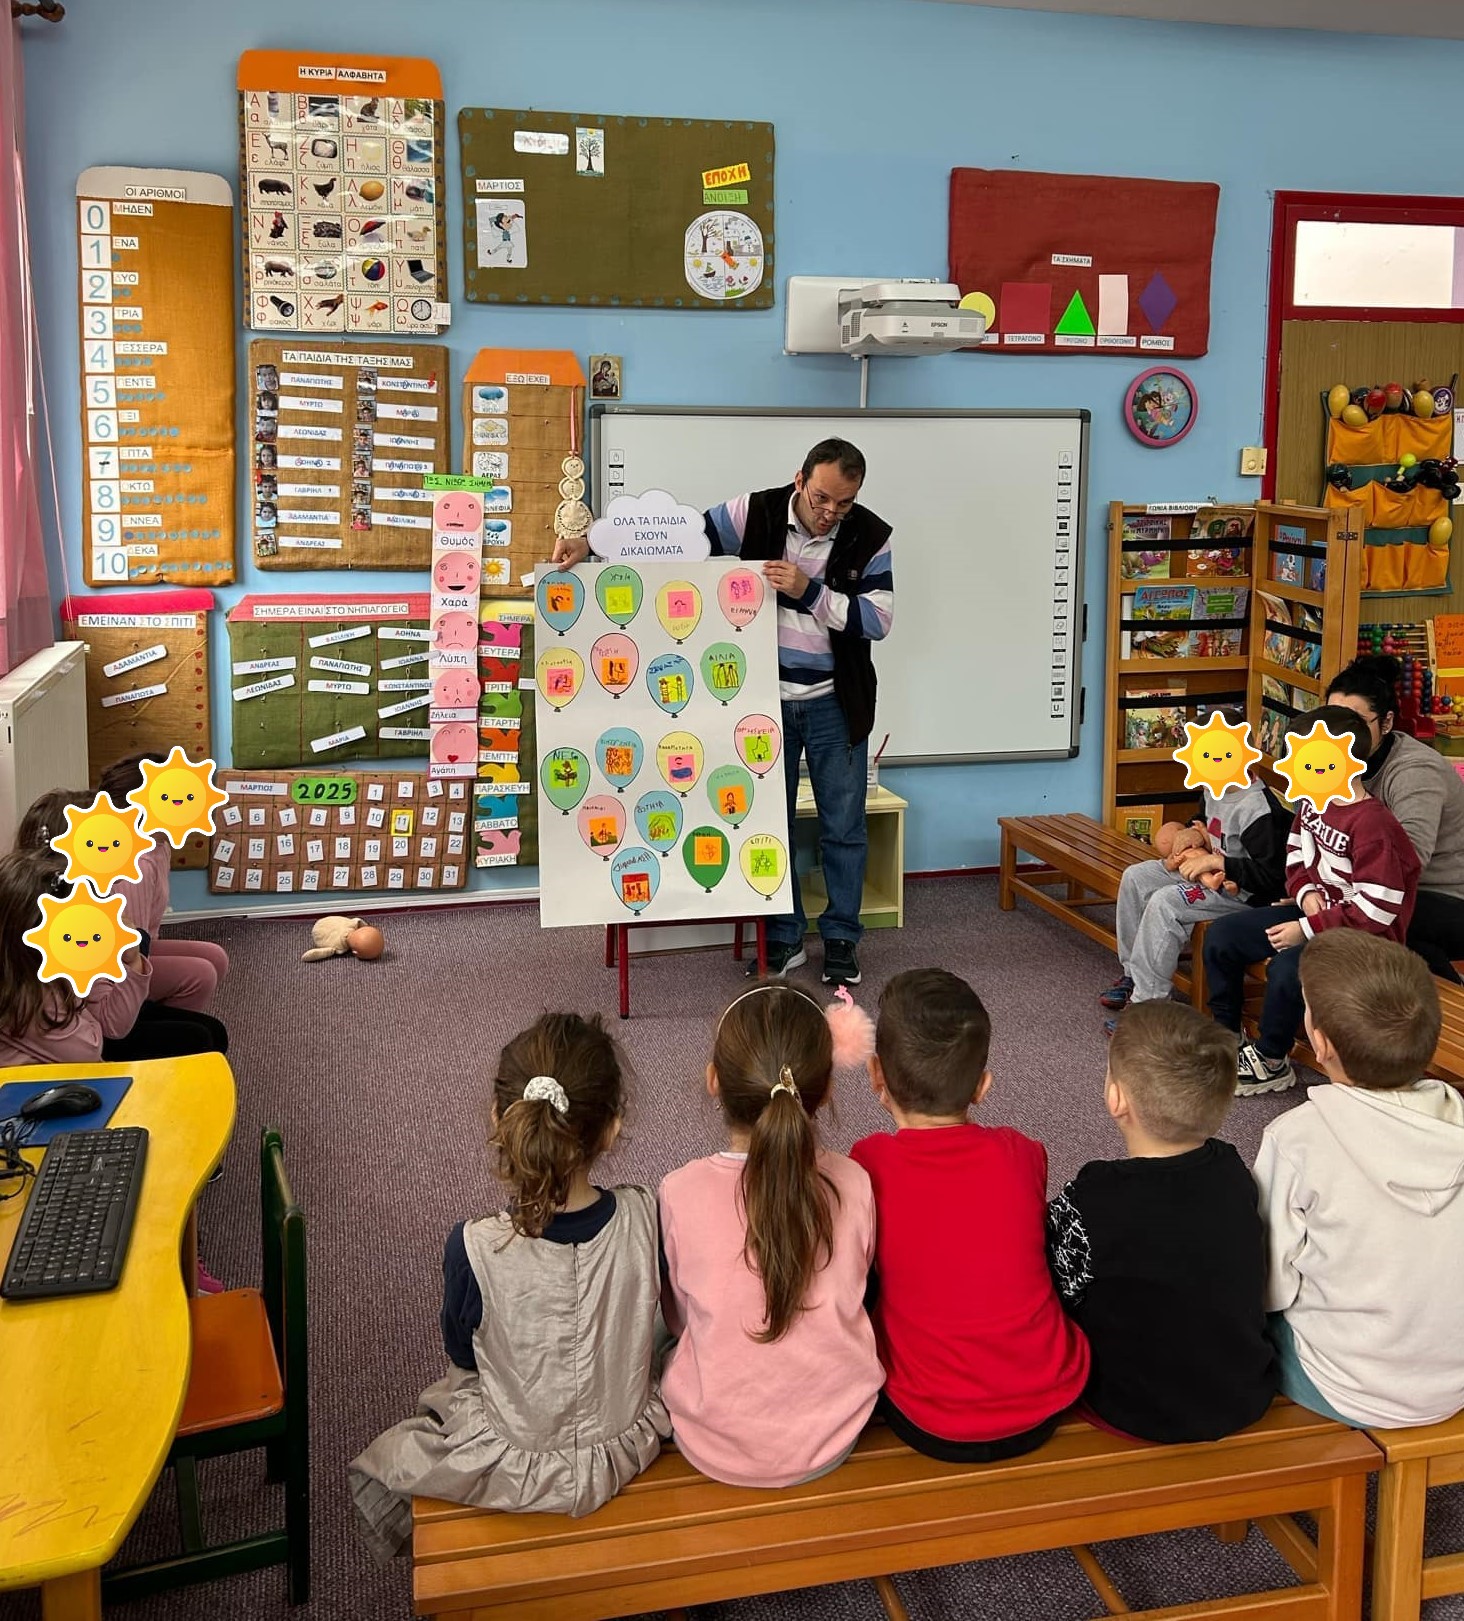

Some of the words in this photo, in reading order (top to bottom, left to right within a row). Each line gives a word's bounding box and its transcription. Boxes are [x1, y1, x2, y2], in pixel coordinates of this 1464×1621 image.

[338, 71, 384, 80] ΑΛΦΑΒΗΤΑ
[705, 167, 747, 186] ΕΠΟΧΗ
[478, 180, 522, 190] ΜΑΡΤΙΟΣ
[126, 187, 136, 196] ΟΙ
[139, 188, 184, 198] ΑΡΙΘΜΟΙ
[87, 205, 103, 229] 0
[90, 240, 100, 264] 1
[89, 275, 105, 299] 2
[91, 310, 106, 334] 3
[91, 345, 107, 368] 4
[284, 352, 296, 361] ΤΑ
[300, 353, 332, 363] ΠΑΙΔΙΑ
[336, 355, 354, 363] ΤΗΣ
[358, 357, 388, 366] ΤΑΞΗΣ
[391, 358, 411, 367] ΜΑΣ
[507, 374, 524, 383] ΕΞΩ
[529, 375, 547, 383] ΕΧΕΙ
[93, 380, 109, 404] 5
[300, 400, 323, 408] ΜΥΡΤΩ
[95, 415, 111, 438] 6
[96, 451, 111, 475] 7
[98, 485, 114, 508] 8
[614, 517, 635, 526] ΟΛΑ
[638, 517, 649, 525] ΤΑ
[653, 517, 687, 525] ΠΑΙΔΙΑ
[98, 518, 114, 542] 9
[635, 531, 667, 540] ΕΧΟΥΝ
[440, 536, 474, 548] Θυμός
[621, 546, 683, 556] ΔΙΚΑΙΩΜΑΤΑ
[96, 553, 126, 574] 10
[441, 597, 468, 610] Χαρά
[255, 607, 297, 616] ΣΗΜΕΡΑ
[298, 607, 323, 615] ΕΙΝΑΙ
[326, 606, 345, 614] ΣΤΟ
[347, 605, 408, 614] ΝΗΠΙΑΓΩΓΕΙΟ
[82, 616, 136, 625] ΕΜΕΙΝΑΝ
[140, 617, 161, 626] ΣΤΟ
[165, 617, 193, 627] ΣΠΙΤΙ
[499, 615, 531, 623] ΣΗΜΕΡΑ
[395, 630, 421, 638] ΑΘΗΝΑ
[479, 648, 519, 657] ΔΕΥΤΕΡΑ
[113, 650, 157, 672] ΑΔΑΜΑΝΤΙΑ
[440, 654, 467, 665] Λύπη
[249, 660, 280, 670] ΑΝΔΡΕΑΣ
[318, 659, 363, 672] ΠΑΝΑΓΙΩΤΗΣ
[245, 680, 282, 694] ΛΕΩΝΙΔΑΣ
[486, 683, 512, 691] ΤΡΙΤΗ
[115, 689, 154, 703] ΠΑΝΑΓΙΩΤΑ
[432, 766, 456, 776] Αγάπη
[298, 783, 352, 800] 2025
[373, 789, 378, 797] 1
[402, 786, 408, 794] 2
[432, 785, 439, 793] 3
[453, 788, 459, 796] 4
[475, 784, 529, 793] ΠΑΡΑΣΚΕΥΗ
[229, 812, 236, 820] 5
[254, 813, 260, 822] 6
[285, 814, 291, 822] 7
[315, 814, 321, 822] 8
[344, 811, 350, 819] 9
[371, 813, 381, 822] 10
[426, 812, 436, 820] 12
[453, 817, 462, 825] 13
[252, 843, 262, 852] 15
[281, 840, 291, 848] 16
[338, 843, 349, 851] 18
[395, 841, 406, 849] 20
[423, 843, 433, 851] 21
[450, 839, 461, 848] 22
[220, 846, 231, 854] 14
[310, 844, 320, 853] 17
[368, 844, 378, 853] 19
[219, 872, 231, 880] 23
[248, 873, 259, 882] 24
[335, 871, 346, 879] 27
[364, 871, 375, 879] 28
[391, 872, 401, 881] 29
[420, 872, 430, 880] 30
[445, 870, 455, 878] 31
[279, 876, 290, 885] 25
[305, 875, 316, 883] 26
